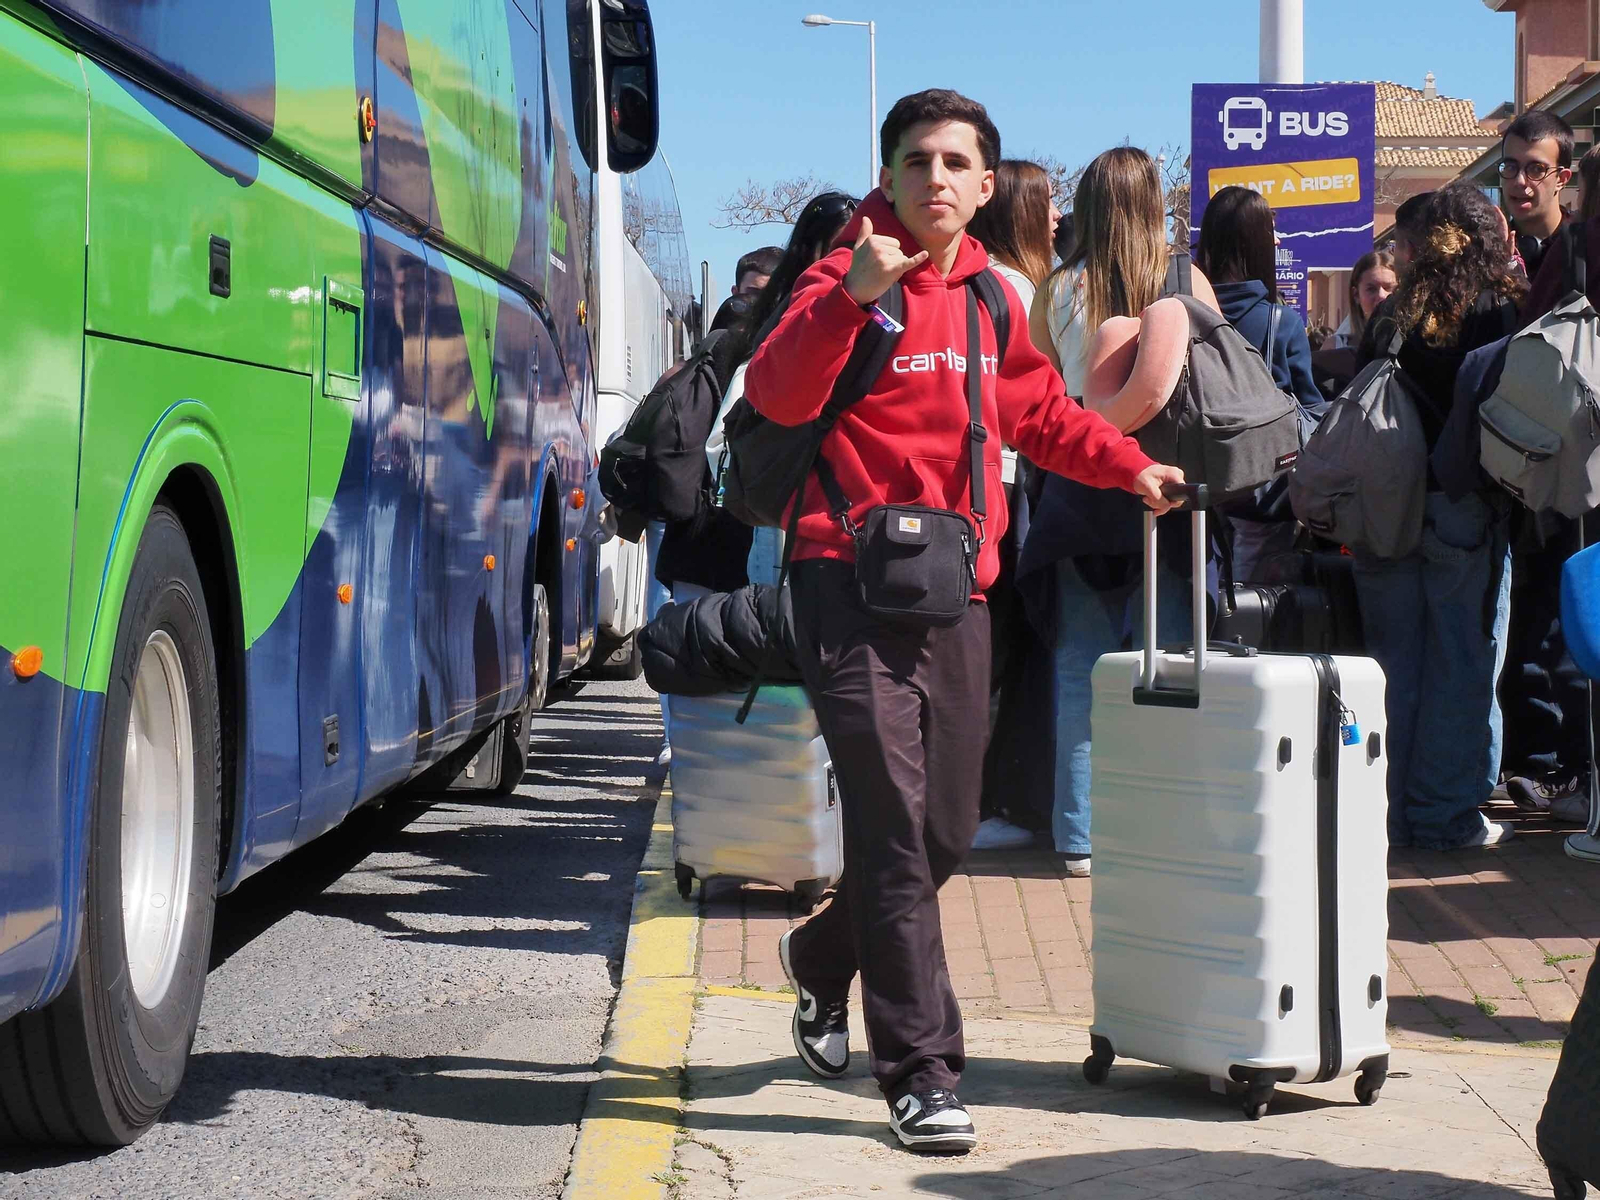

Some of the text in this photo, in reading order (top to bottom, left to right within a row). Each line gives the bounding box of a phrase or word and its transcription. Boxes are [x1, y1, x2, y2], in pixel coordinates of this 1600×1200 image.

[1279, 112, 1349, 137] BUS
[1213, 174, 1355, 195] NT A RIDE?
[892, 347, 998, 375] carhatt
